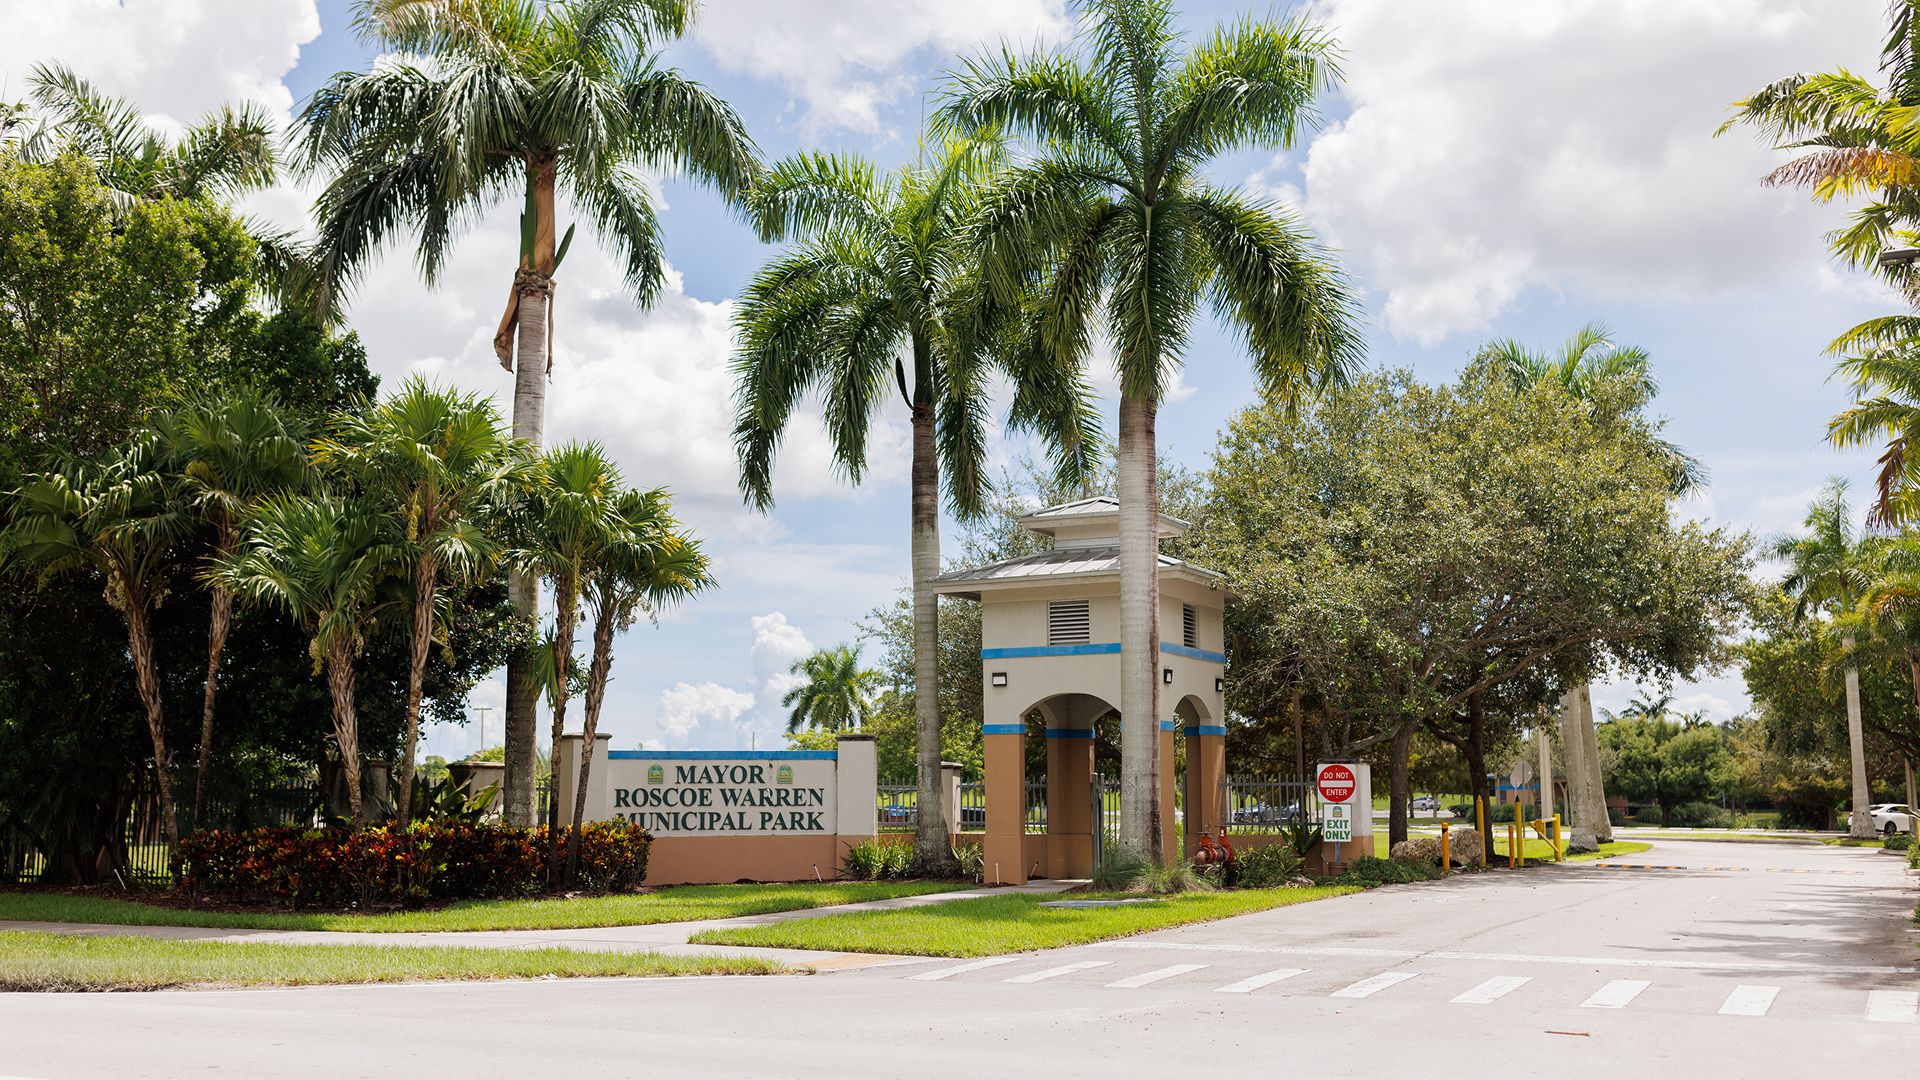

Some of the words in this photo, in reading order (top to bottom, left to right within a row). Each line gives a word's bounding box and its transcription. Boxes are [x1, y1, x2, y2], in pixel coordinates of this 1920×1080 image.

[675, 765, 765, 784] MAYOR
[614, 788, 712, 807] ROSCOE
[720, 788, 825, 807] WARREN
[759, 811, 825, 831] PARK
[1327, 819, 1349, 829] EXIT
[1325, 830, 1351, 840] ONLY
